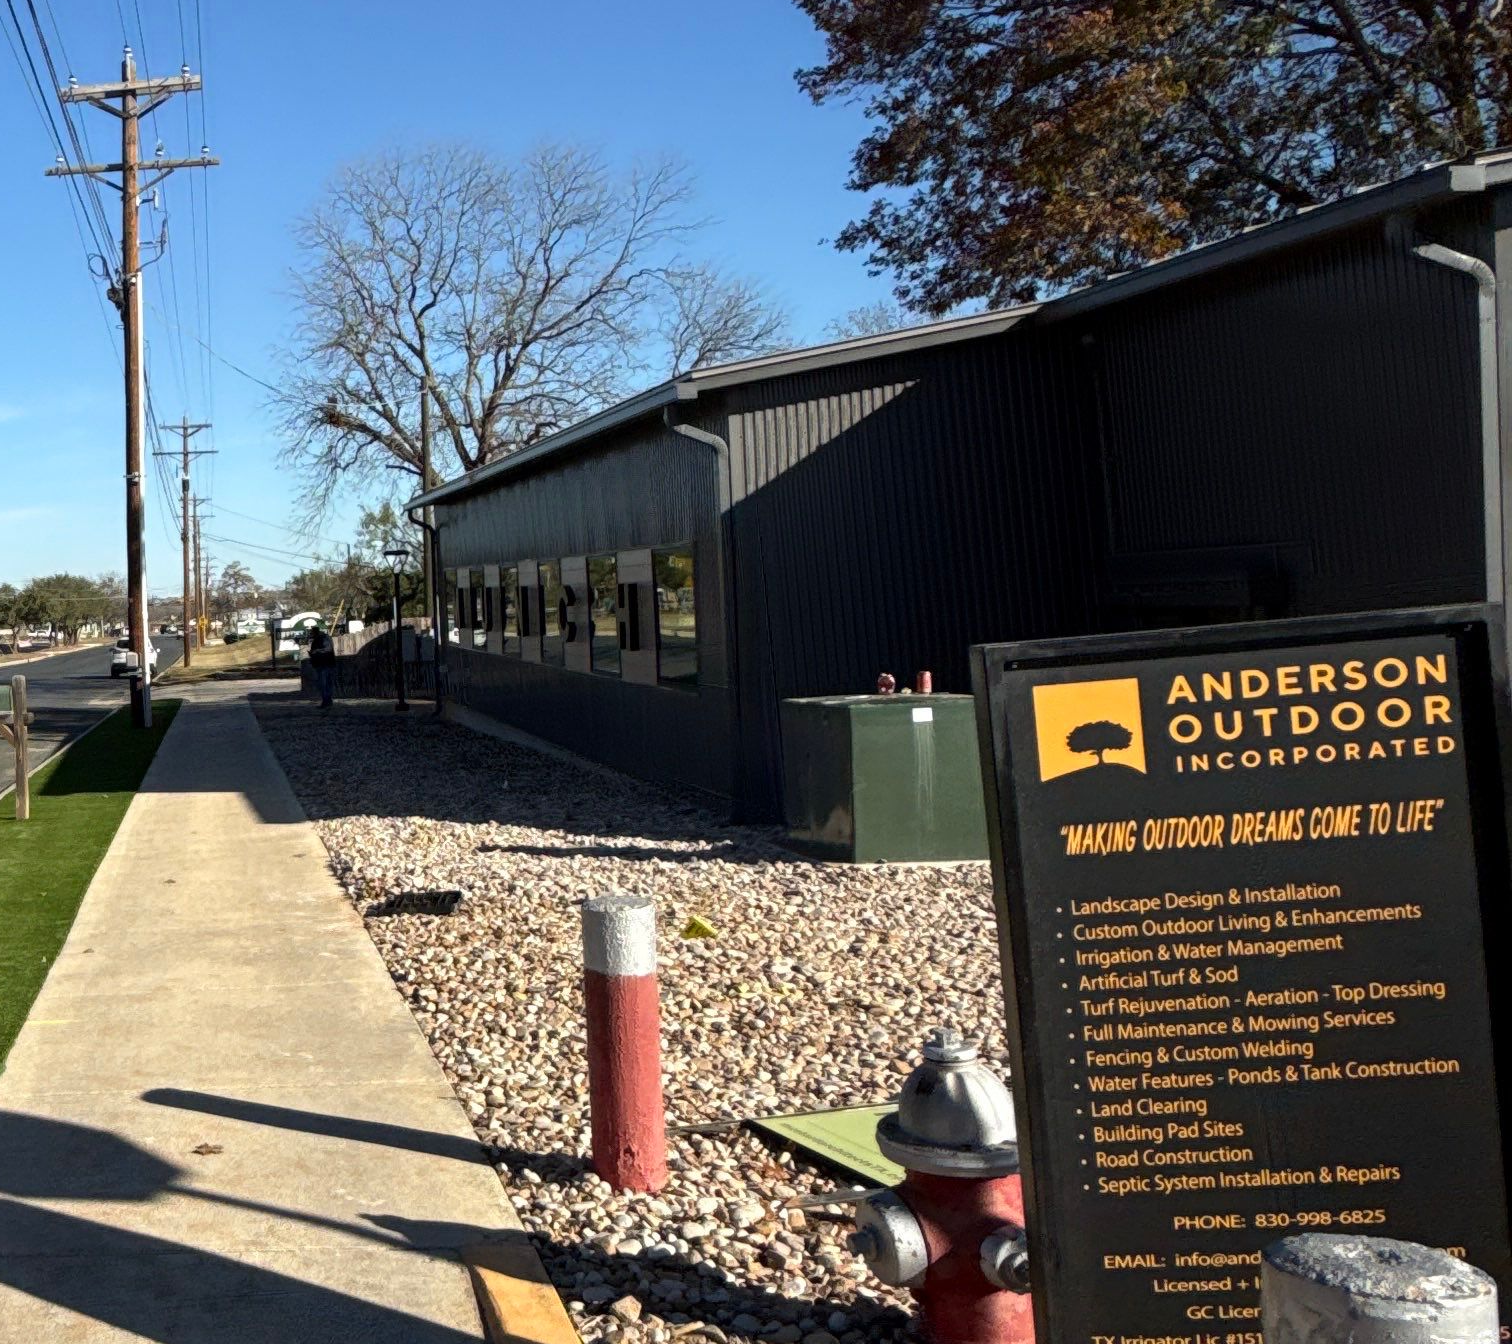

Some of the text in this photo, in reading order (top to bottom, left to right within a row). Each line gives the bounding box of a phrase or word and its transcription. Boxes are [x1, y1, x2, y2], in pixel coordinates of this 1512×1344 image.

[1167, 654, 1447, 704] ANDERSON
[1168, 695, 1452, 743] OUTDOOR
[1176, 736, 1455, 772] INCORPORATED
[1143, 815, 1224, 850] OUTDOOR
[1230, 808, 1304, 846] DREAMS
[1310, 805, 1362, 839] COME
[1369, 802, 1392, 834] TO
[1072, 884, 1340, 915] Landscape Design & Installation
[1074, 904, 1422, 940] Custom Outdoor Living & Enhancements
[1076, 935, 1343, 968] Irrigation & Water Management
[1080, 966, 1238, 990] Artificial Turf & Sod
[1081, 998, 1114, 1016] Turf
[1118, 994, 1230, 1017] Rejuvenation
[1246, 989, 1318, 1006] Aeration
[1333, 985, 1365, 1004] Top
[1369, 981, 1445, 999] Dressing
[1084, 1010, 1395, 1041] Full Maintenance & Mowing Services
[1086, 1040, 1314, 1068] Fencing & Custom Welding
[1088, 1076, 1137, 1092] Water
[1142, 1073, 1214, 1088] Features
[1228, 1066, 1281, 1084] Ponds
[1286, 1065, 1298, 1081] &
[1302, 1062, 1342, 1080] Tank
[1346, 1058, 1459, 1078] Construction
[1092, 1098, 1207, 1117] Land Clearing
[1094, 1121, 1243, 1144] Building Pad Sites
[1096, 1146, 1252, 1168] Road Construction
[1098, 1164, 1400, 1196] Septic System Installation & Repairs
[1174, 1210, 1385, 1230] PHONE: 830-998-6825
[1104, 1254, 1165, 1268] EMAIL:
[1154, 1277, 1231, 1292] Licensed
[1237, 1278, 1250, 1291] +
[1187, 1306, 1212, 1319] GC
